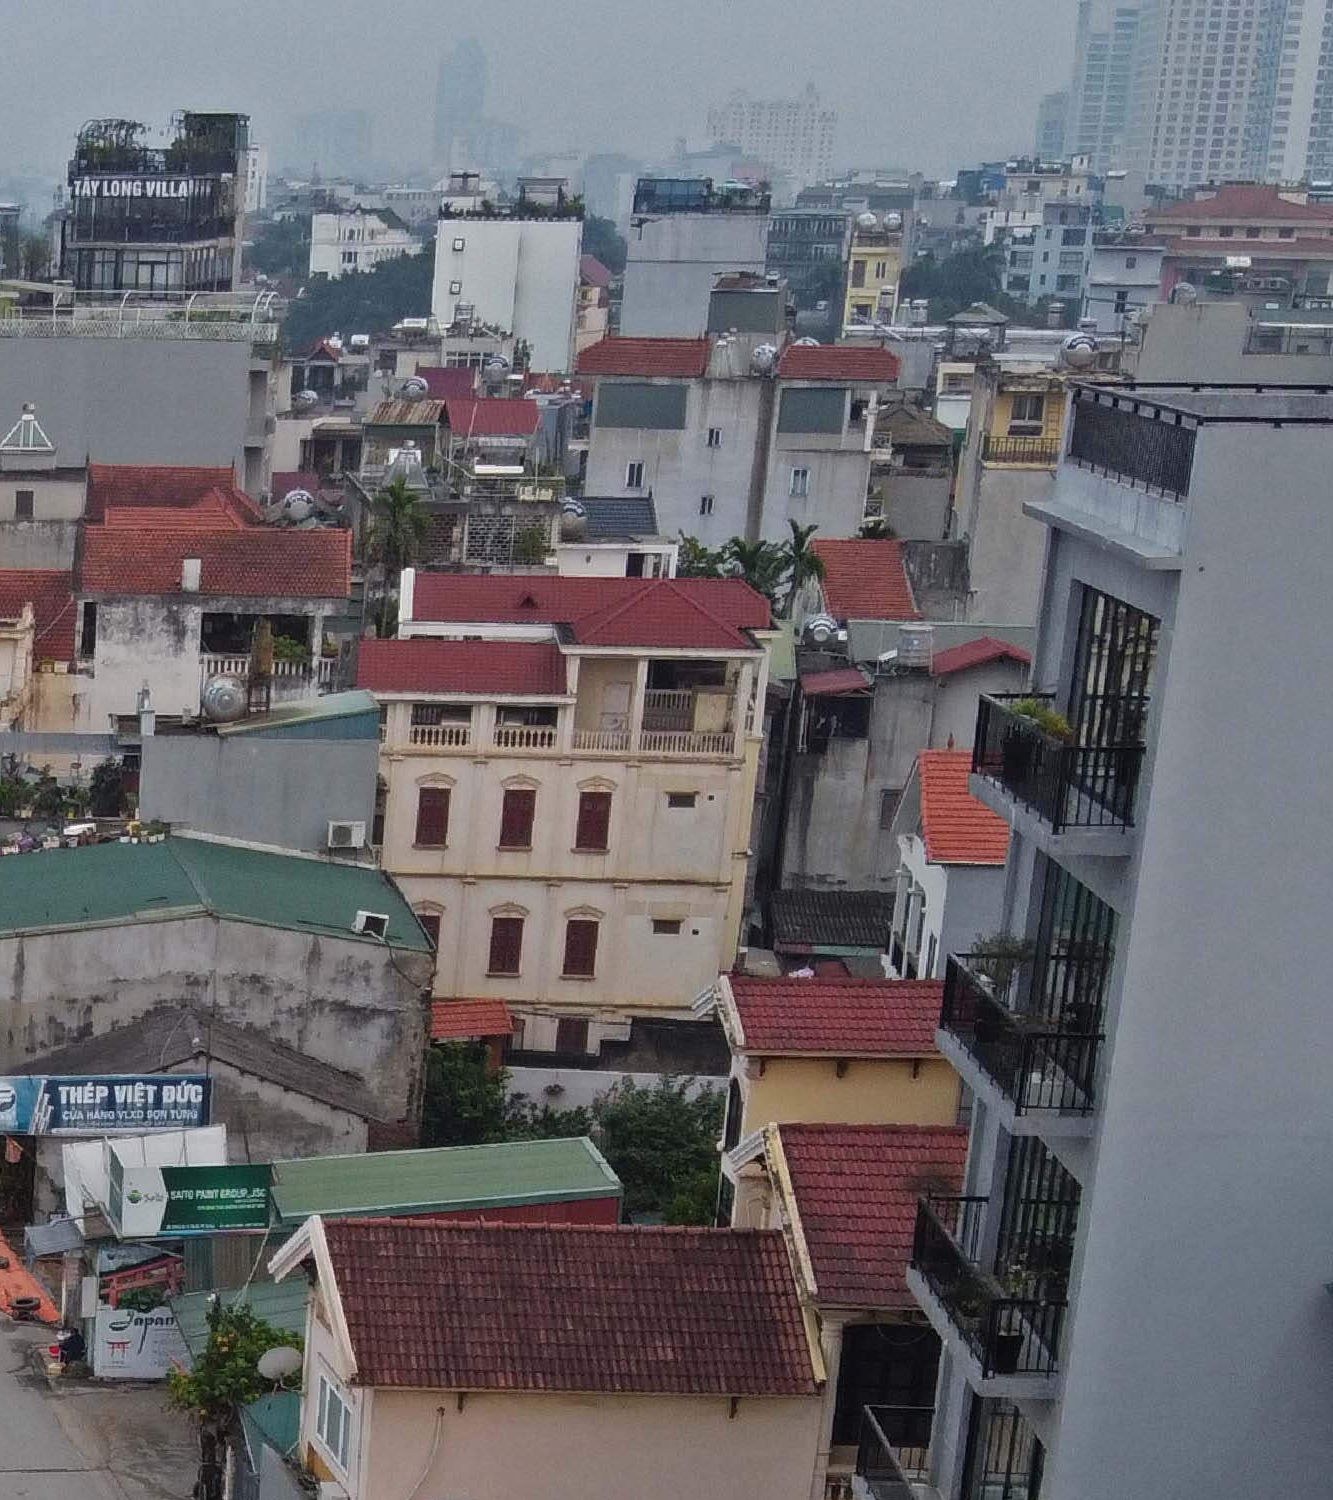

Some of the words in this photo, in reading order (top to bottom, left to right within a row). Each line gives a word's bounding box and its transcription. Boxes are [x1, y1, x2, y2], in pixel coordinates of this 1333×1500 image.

[74, 177, 100, 197] TÂY
[102, 180, 142, 197] LONG
[145, 180, 188, 198] VILLA
[58, 1081, 109, 1104] THÉP
[114, 1081, 158, 1106] VIỆT
[161, 1079, 204, 1103] ĐỨC
